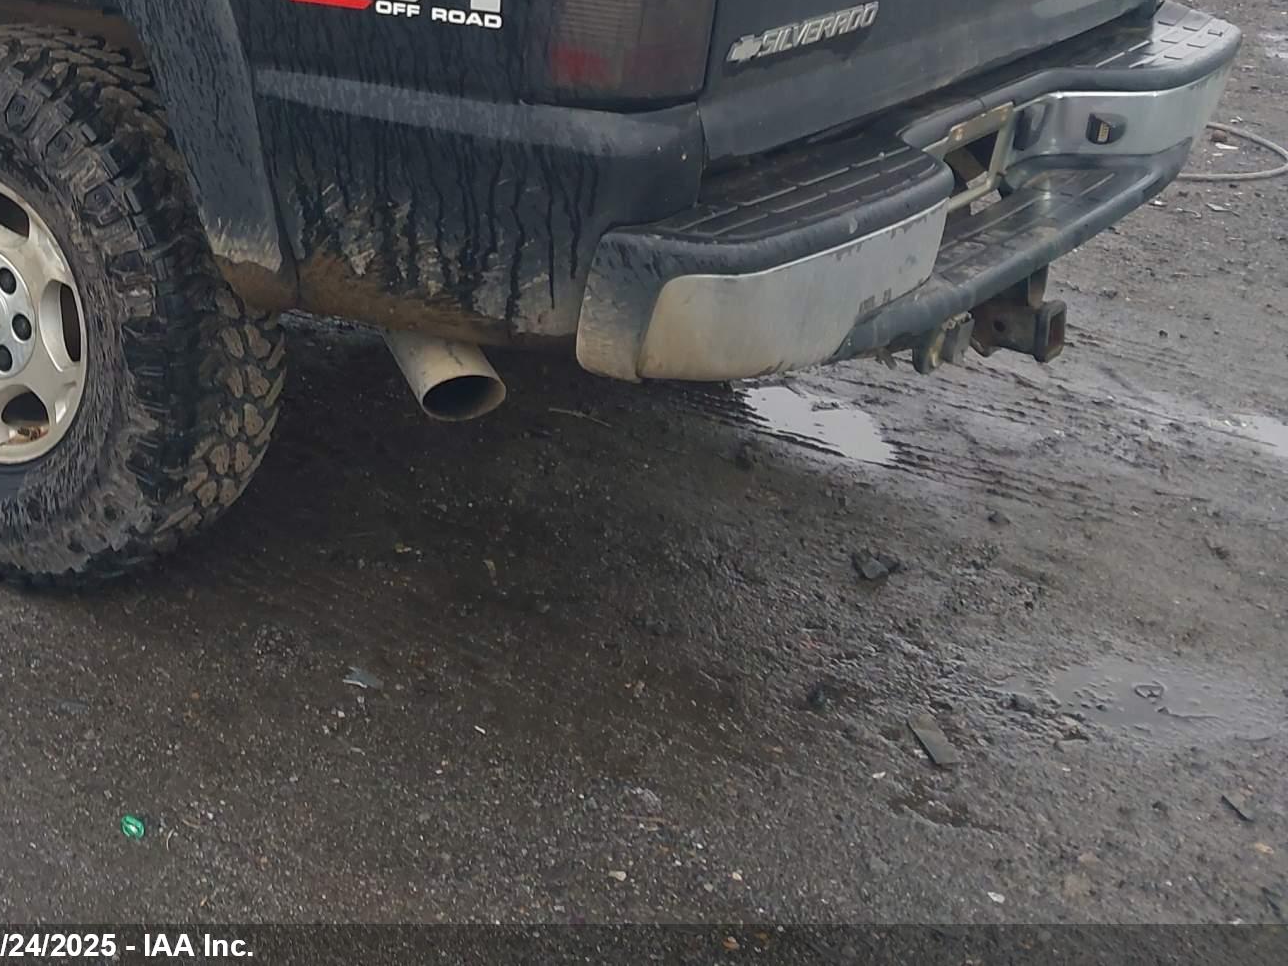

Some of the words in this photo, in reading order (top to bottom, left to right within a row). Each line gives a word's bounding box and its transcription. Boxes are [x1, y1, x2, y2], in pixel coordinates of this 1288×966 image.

[375, 0, 420, 17] OFF
[431, 7, 503, 29] ROAD
[757, 0, 880, 58] SILVERADO
